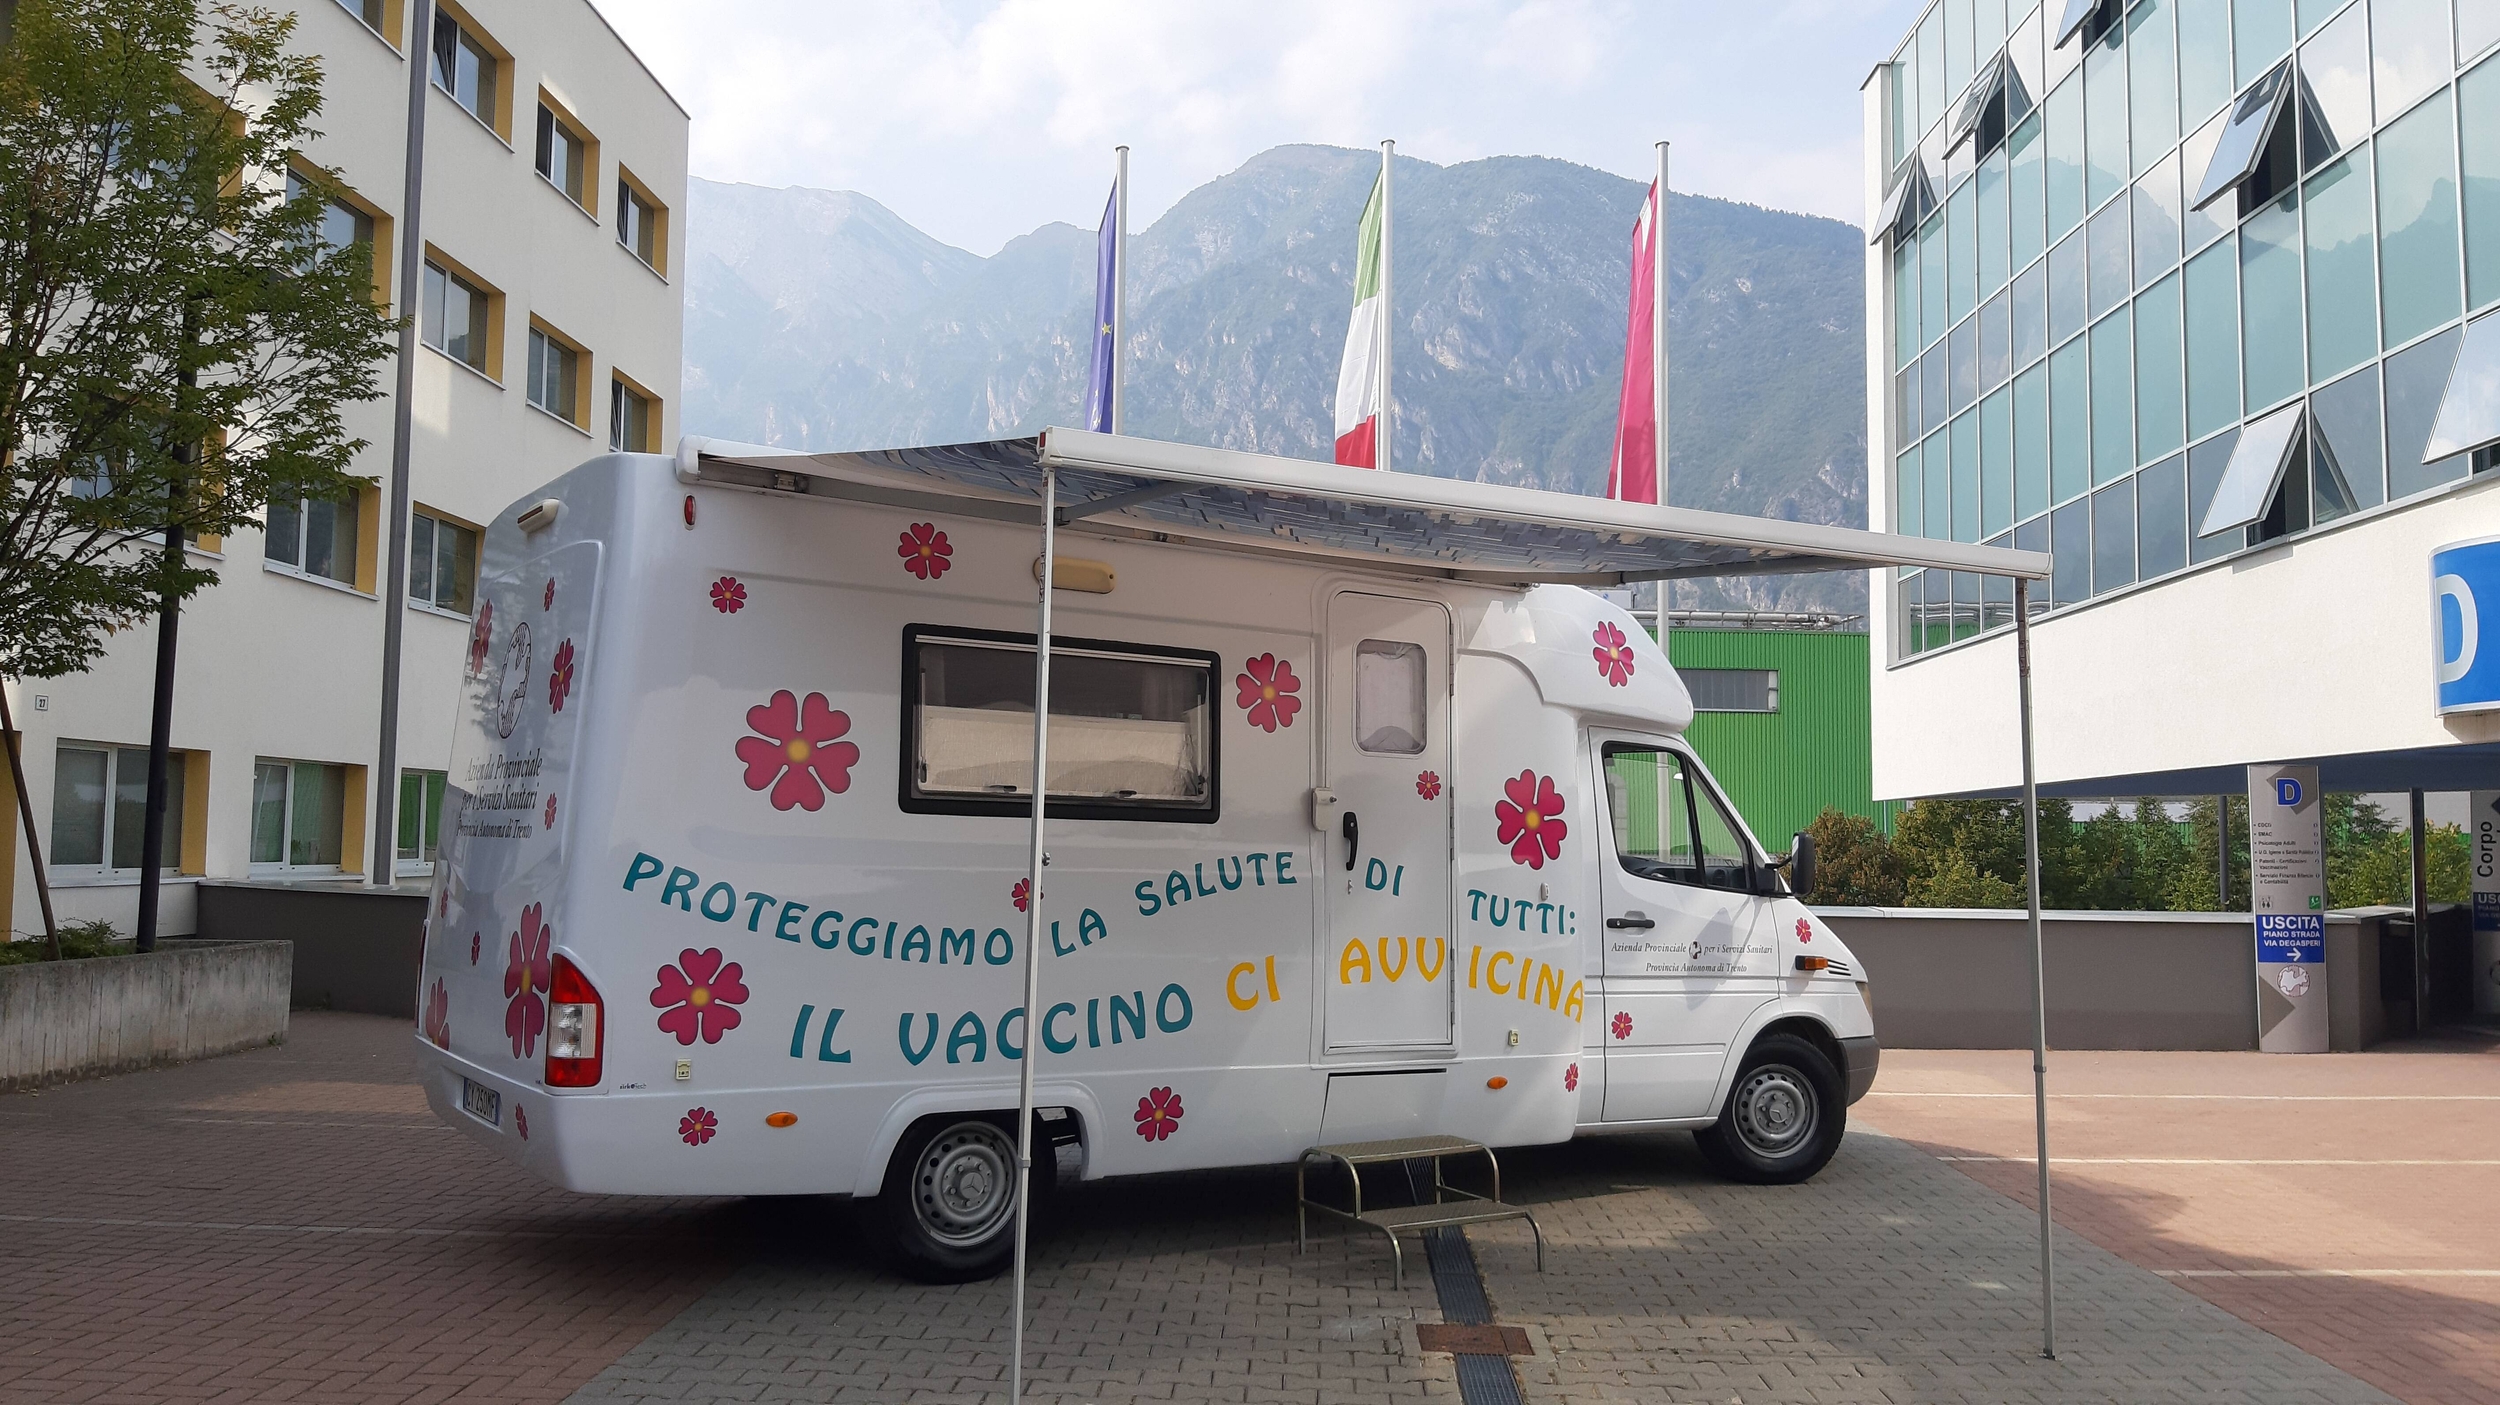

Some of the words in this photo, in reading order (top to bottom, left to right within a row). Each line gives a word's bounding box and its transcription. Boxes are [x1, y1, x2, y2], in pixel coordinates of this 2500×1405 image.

[2435, 573, 2479, 685] D
[494, 748, 543, 780] Provinciale
[459, 792, 474, 819] per
[477, 783, 506, 811] Servizi
[503, 782, 540, 811] Sanitari
[2275, 777, 2303, 806] D
[512, 819, 533, 839] Trento
[2477, 821, 2497, 878] Corpo
[622, 851, 1014, 965] PROTEGGIAMO
[1051, 908, 1107, 957] LA
[1134, 851, 1298, 916] SALUTE
[1365, 857, 1405, 897] DI
[1467, 889, 1576, 935] TUTTI:
[2262, 916, 2320, 930] USCITA
[1611, 942, 1642, 952] Azienda
[1644, 942, 1687, 953] Provinciale
[1703, 945, 1716, 956] per
[1721, 944, 1746, 954] Servizi
[1746, 944, 1773, 954] Sanitari
[1645, 963, 1679, 973] Provincia
[1681, 963, 1716, 973] Autonoma
[1716, 962, 1724, 972] di
[1725, 963, 1748, 973] Trento
[789, 1004, 852, 1064] IL
[899, 983, 1193, 1066] VACCINO
[1226, 955, 1281, 1011] CI
[1340, 936, 1584, 1023] AVVICINA
